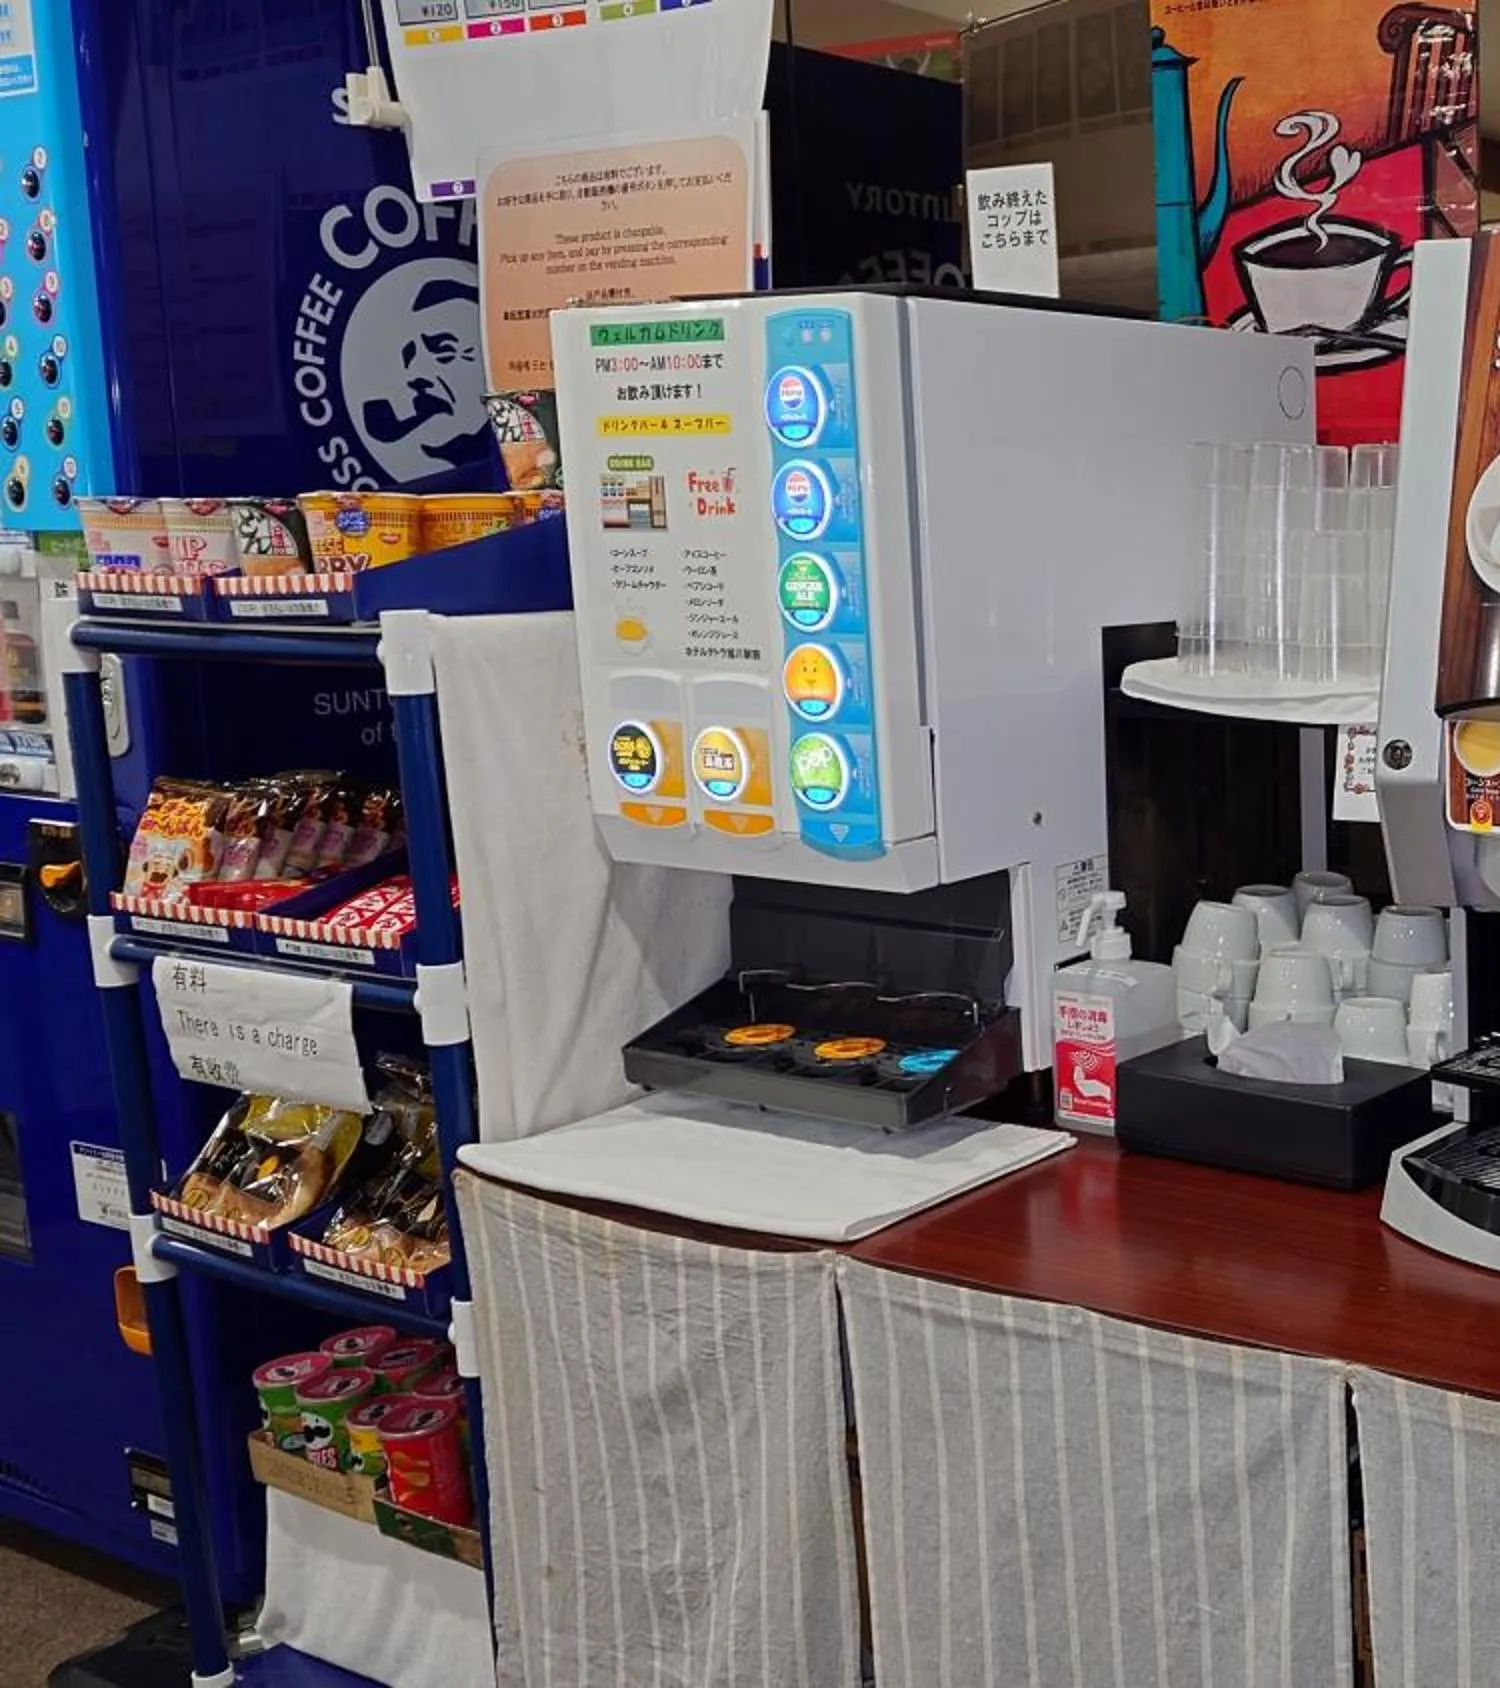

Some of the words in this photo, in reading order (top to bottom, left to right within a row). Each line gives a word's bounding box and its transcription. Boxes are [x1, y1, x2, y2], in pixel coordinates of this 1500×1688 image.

[977, 189, 1047, 211] 飲み終えた
[987, 209, 1042, 228] コップは
[981, 228, 1049, 249] こちらまで
[597, 320, 722, 341] ウェルカムドリンク
[294, 272, 343, 427] COFFEE
[687, 471, 721, 493] Free
[697, 496, 737, 516] Drink
[176, 1009, 220, 1037] There
[229, 1022, 245, 1041] is
[252, 1028, 261, 1044] a
[267, 1027, 318, 1056] charge
